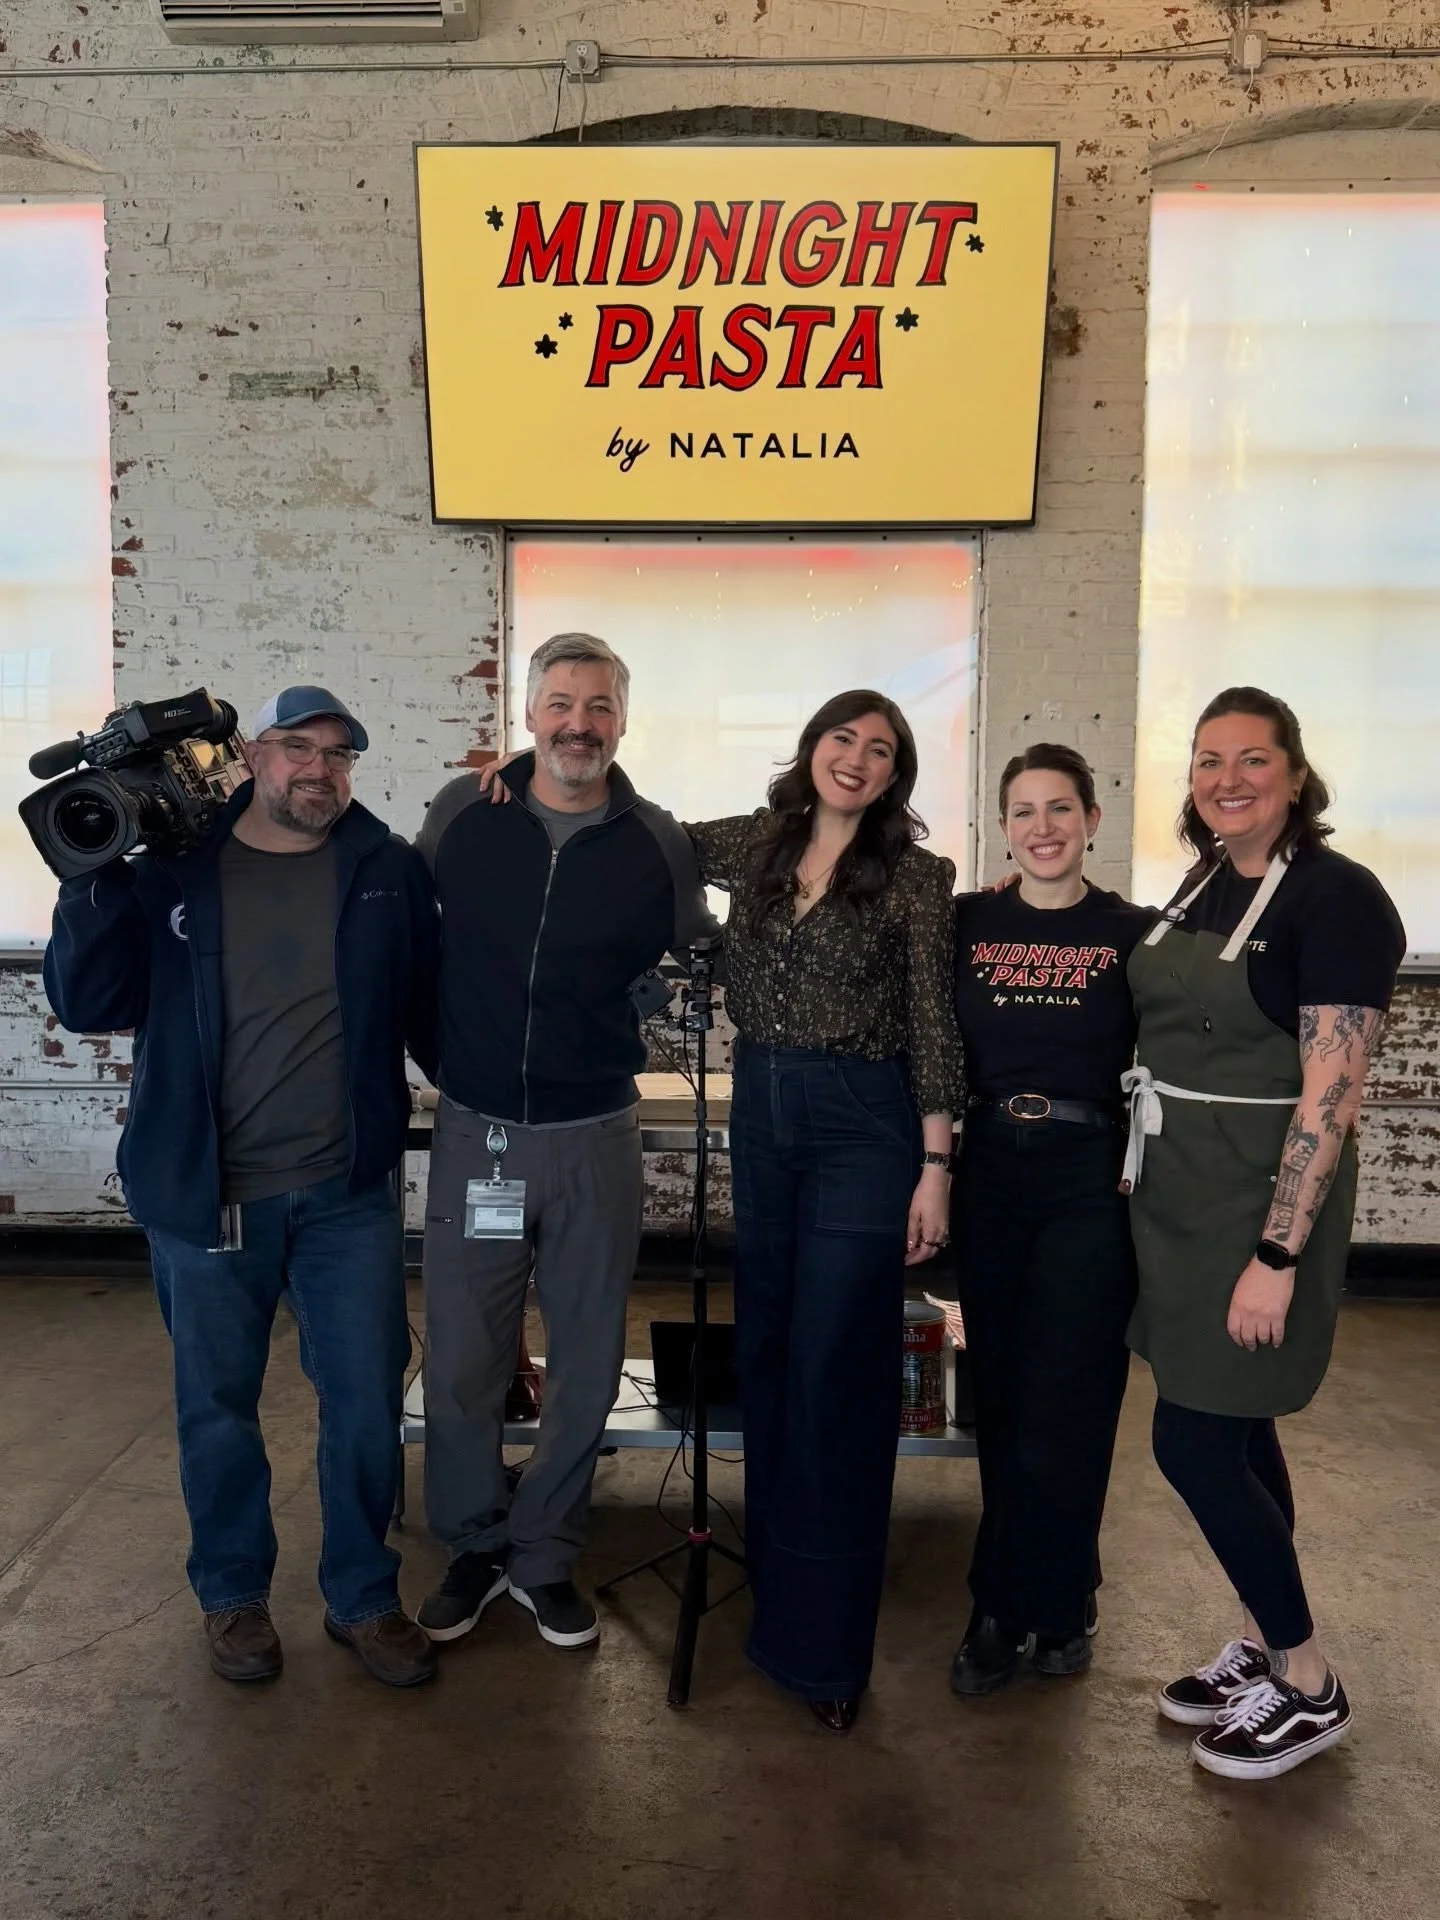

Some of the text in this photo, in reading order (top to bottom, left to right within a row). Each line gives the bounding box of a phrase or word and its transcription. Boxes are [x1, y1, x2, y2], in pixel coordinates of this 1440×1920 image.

[497, 199, 978, 290] MIDNIGHT
[584, 303, 885, 392] PASTA
[606, 426, 860, 472] by NATALIA
[971, 942, 1118, 970] MIDNIGHT
[988, 964, 1088, 989] PASTA
[992, 993, 1081, 1007] by NATALIA
